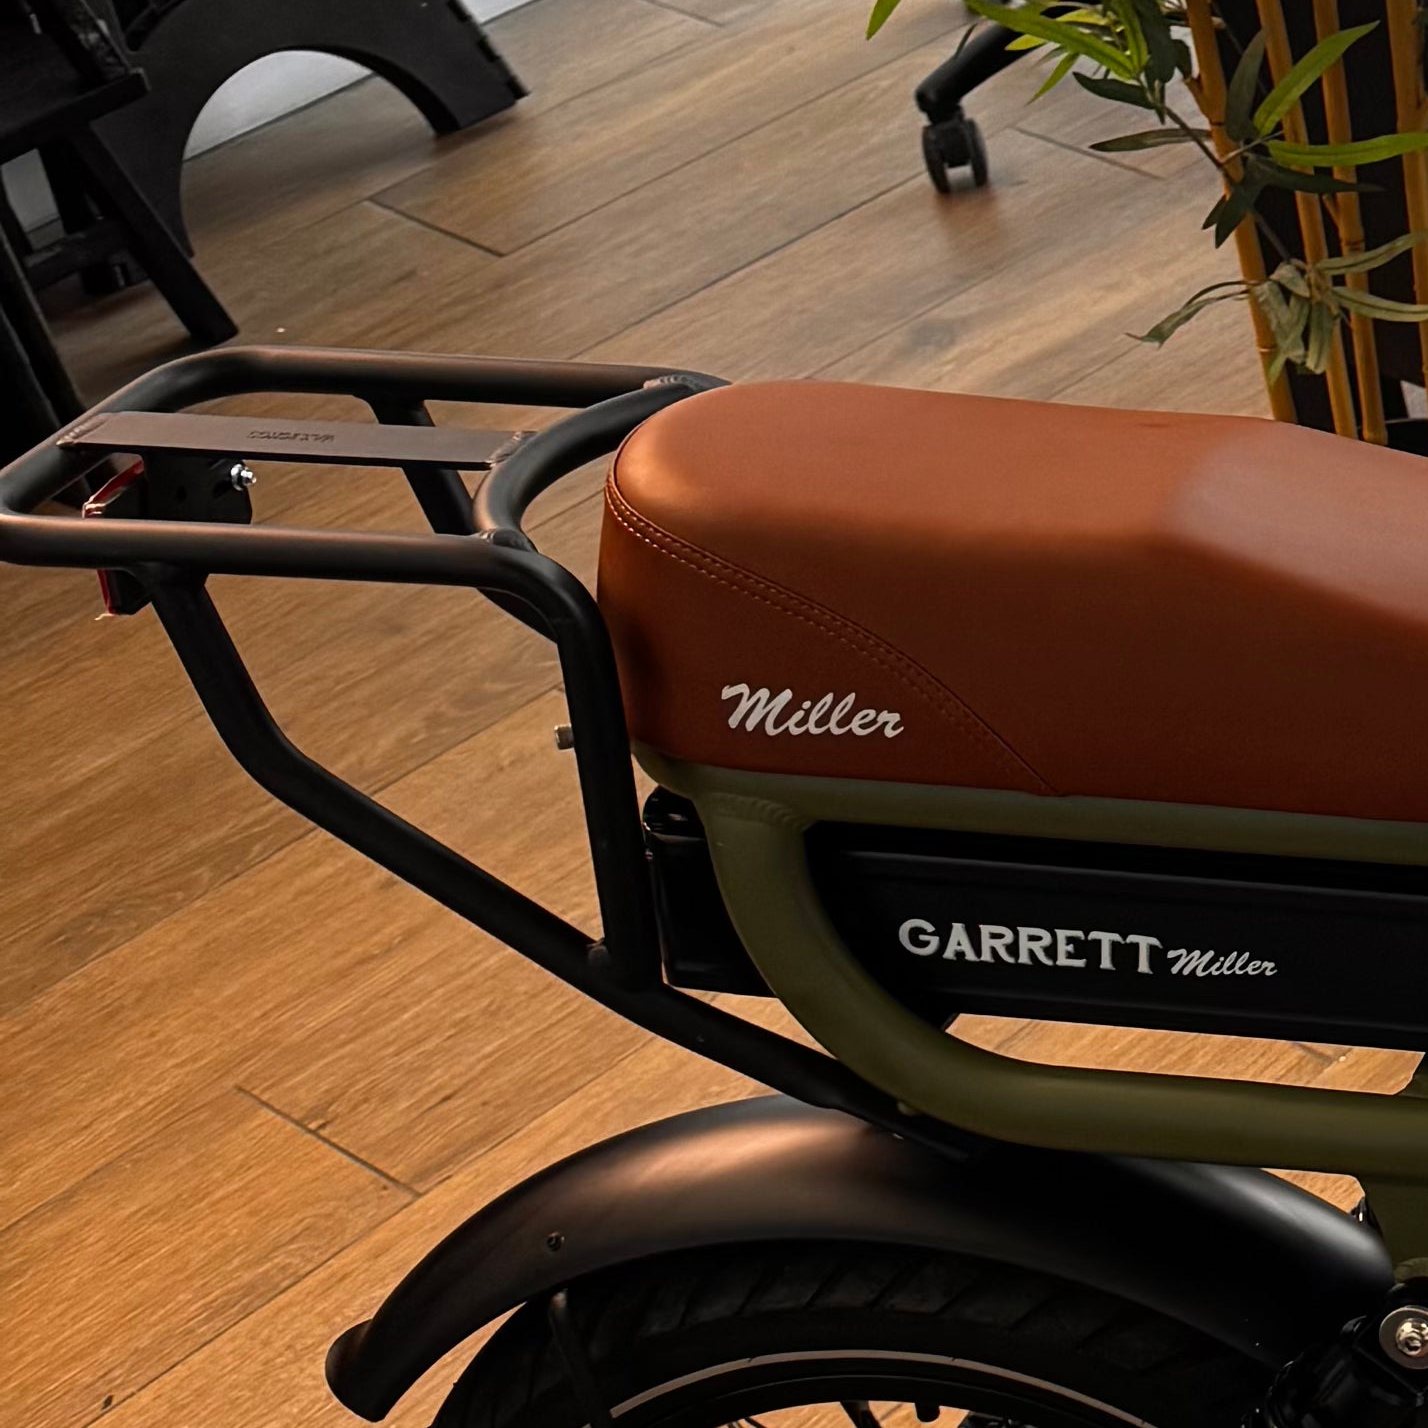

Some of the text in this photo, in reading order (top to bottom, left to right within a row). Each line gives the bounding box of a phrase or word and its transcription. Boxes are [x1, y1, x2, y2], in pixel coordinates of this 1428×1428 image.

[720, 683, 905, 740] Miller
[897, 916, 1278, 978] GARRETT Miller
